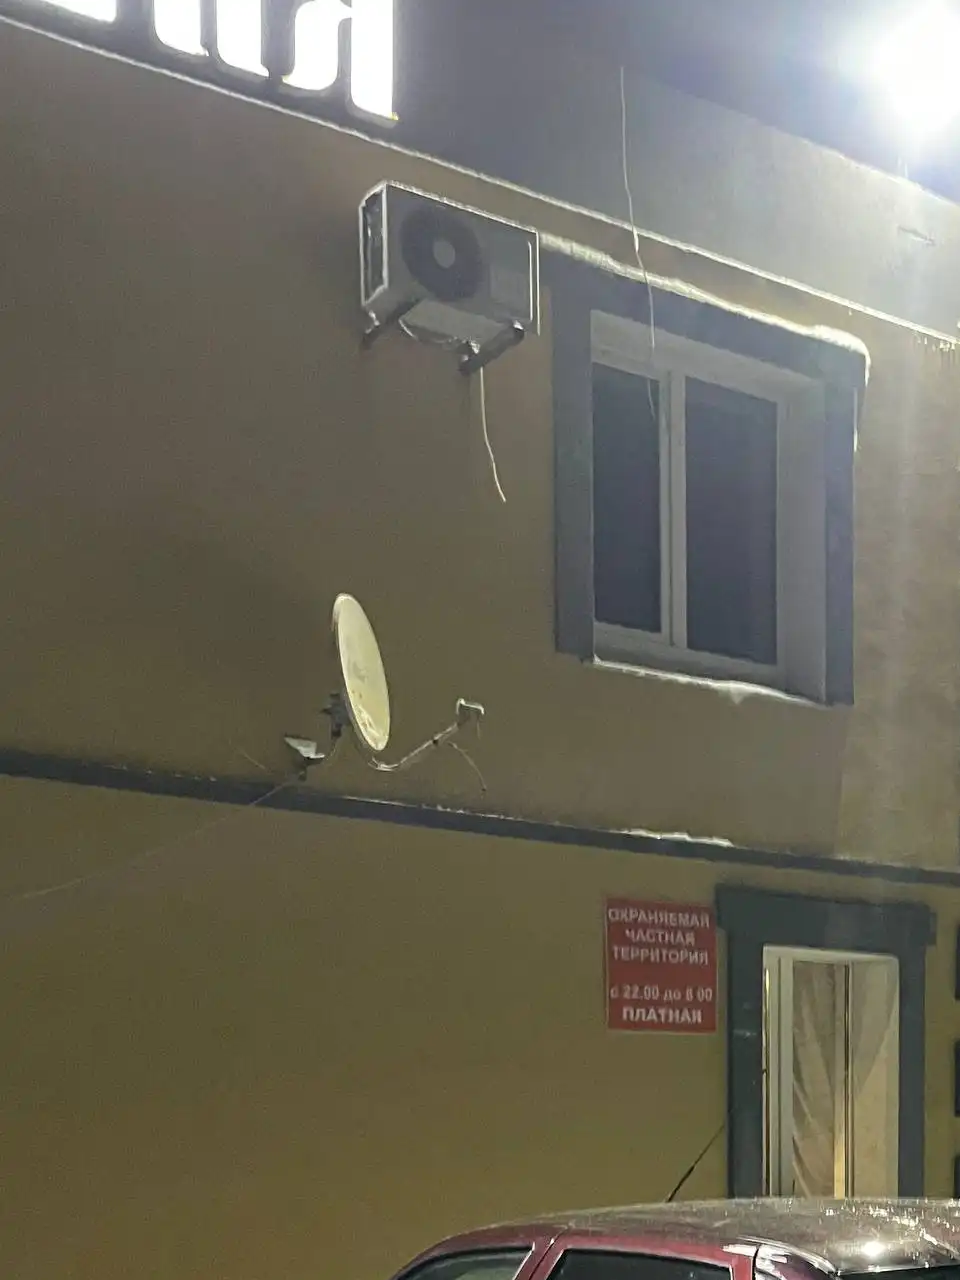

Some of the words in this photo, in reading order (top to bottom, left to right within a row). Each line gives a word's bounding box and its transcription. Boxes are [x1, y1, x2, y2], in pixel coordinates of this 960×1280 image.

[608, 908, 710, 928] ОХРАНЯЕМАЯ
[625, 929, 695, 947] ЧАСТНАЯ
[613, 946, 709, 965] ТЕРРИТОРИЯ
[663, 988, 681, 1002] до
[622, 1006, 702, 1024] ПЛАТНАЯ
